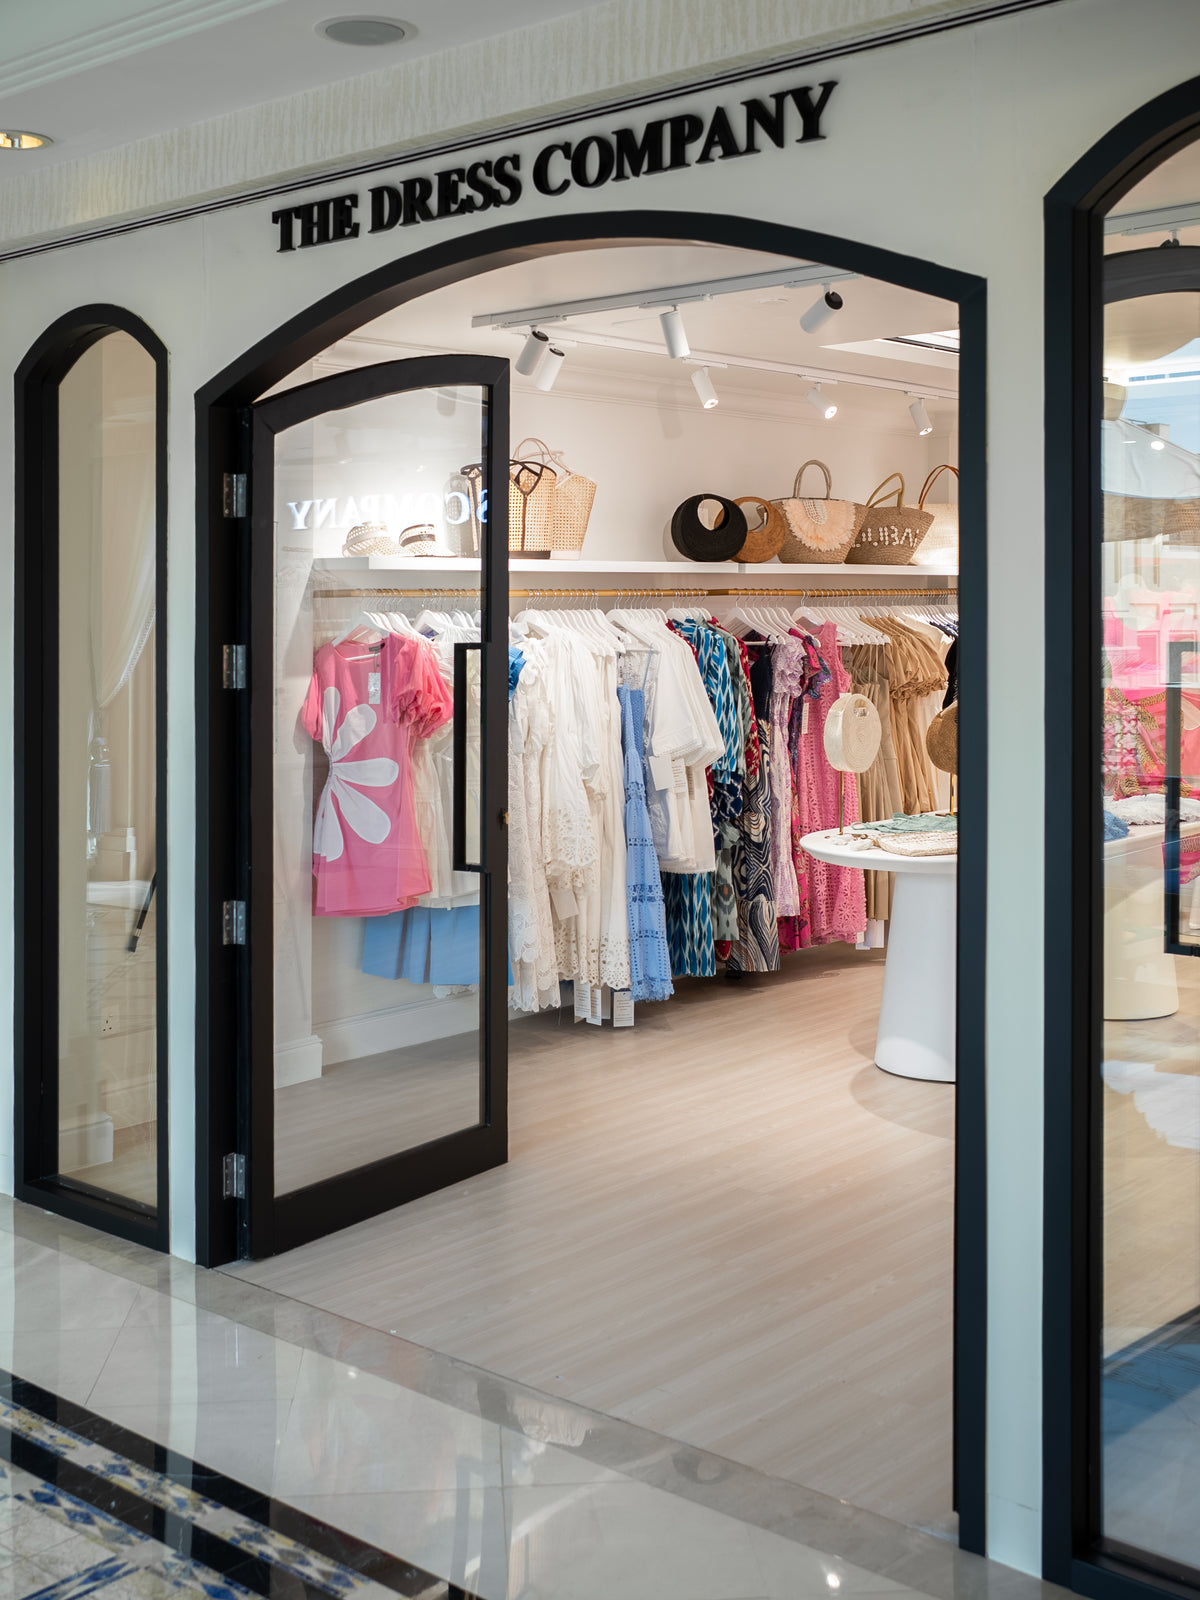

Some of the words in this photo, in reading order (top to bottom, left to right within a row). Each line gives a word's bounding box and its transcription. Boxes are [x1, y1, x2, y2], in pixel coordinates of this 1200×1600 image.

[272, 193, 360, 253] THE
[367, 153, 522, 235] DRESS
[532, 81, 838, 196] COMPANY
